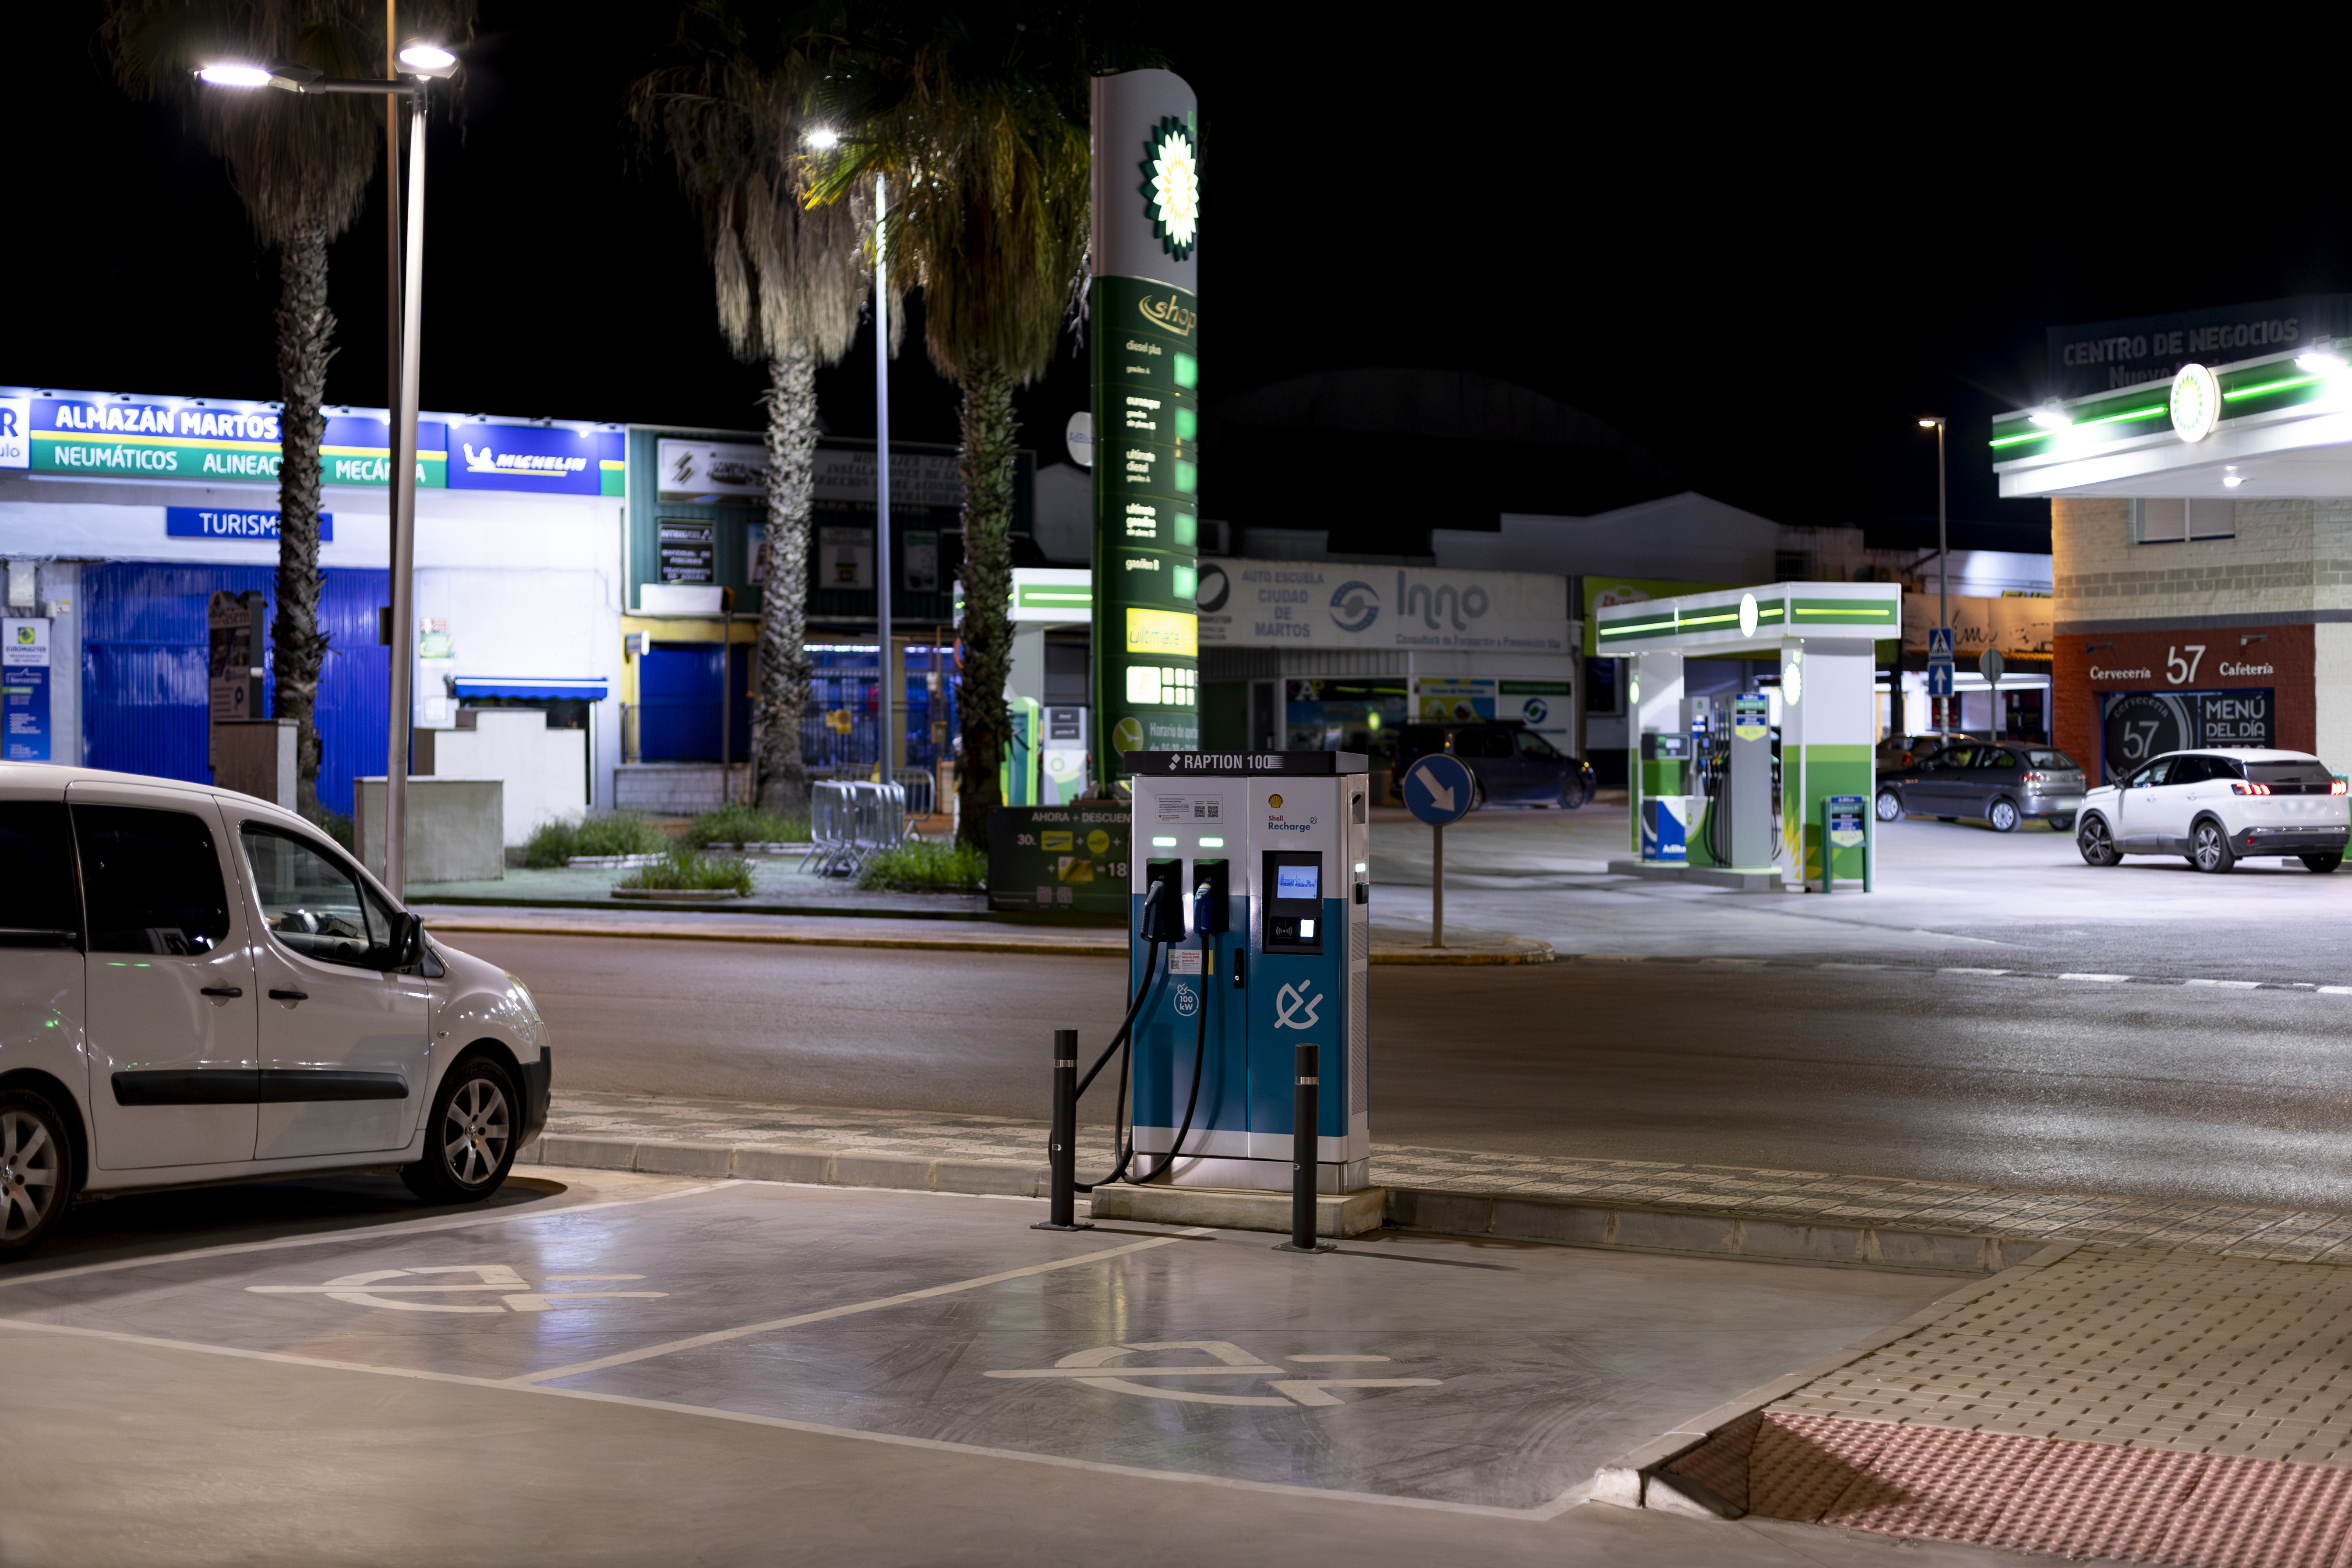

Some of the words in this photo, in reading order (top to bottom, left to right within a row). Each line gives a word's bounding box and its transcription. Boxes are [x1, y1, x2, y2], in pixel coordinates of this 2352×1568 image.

[1139, 295, 1197, 336] shop
[2063, 335, 2147, 366] CENTRO
[2154, 331, 2183, 357] DE
[2189, 318, 2299, 353] NEGOCIOS
[56, 405, 174, 433] ALMAZÁN
[180, 412, 279, 439] MARTOS
[55, 445, 178, 471] NEUMÁTICOS
[203, 453, 282, 476] ALINEAC
[336, 458, 426, 483] MECÁA
[496, 454, 587, 472] MICHELIN
[1126, 449, 1156, 463] ultimate
[1126, 461, 1149, 473] diesel
[199, 513, 281, 536] TURISM
[1242, 571, 1271, 583] AUTO
[1275, 572, 1324, 584] ESCUELA
[1258, 589, 1308, 604] CIUDAD
[1275, 606, 1292, 620] DE
[1129, 625, 1180, 646] ultimate
[1255, 622, 1310, 637] MARTOS
[2090, 665, 2151, 680] Cervecería
[2166, 645, 2206, 685] 57
[2219, 661, 2274, 677] Cafetería
[2206, 695, 2265, 720] MENÚ
[2206, 723, 2236, 737] DEL
[2239, 720, 2265, 737] DÍA
[2123, 721, 2160, 759] 57
[1185, 755, 1242, 769] RAPTION
[1247, 755, 1272, 769] 100
[1031, 812, 1070, 823] AHORA
[1082, 812, 1133, 823] DESCUEN
[1268, 822, 1310, 832] Recharge
